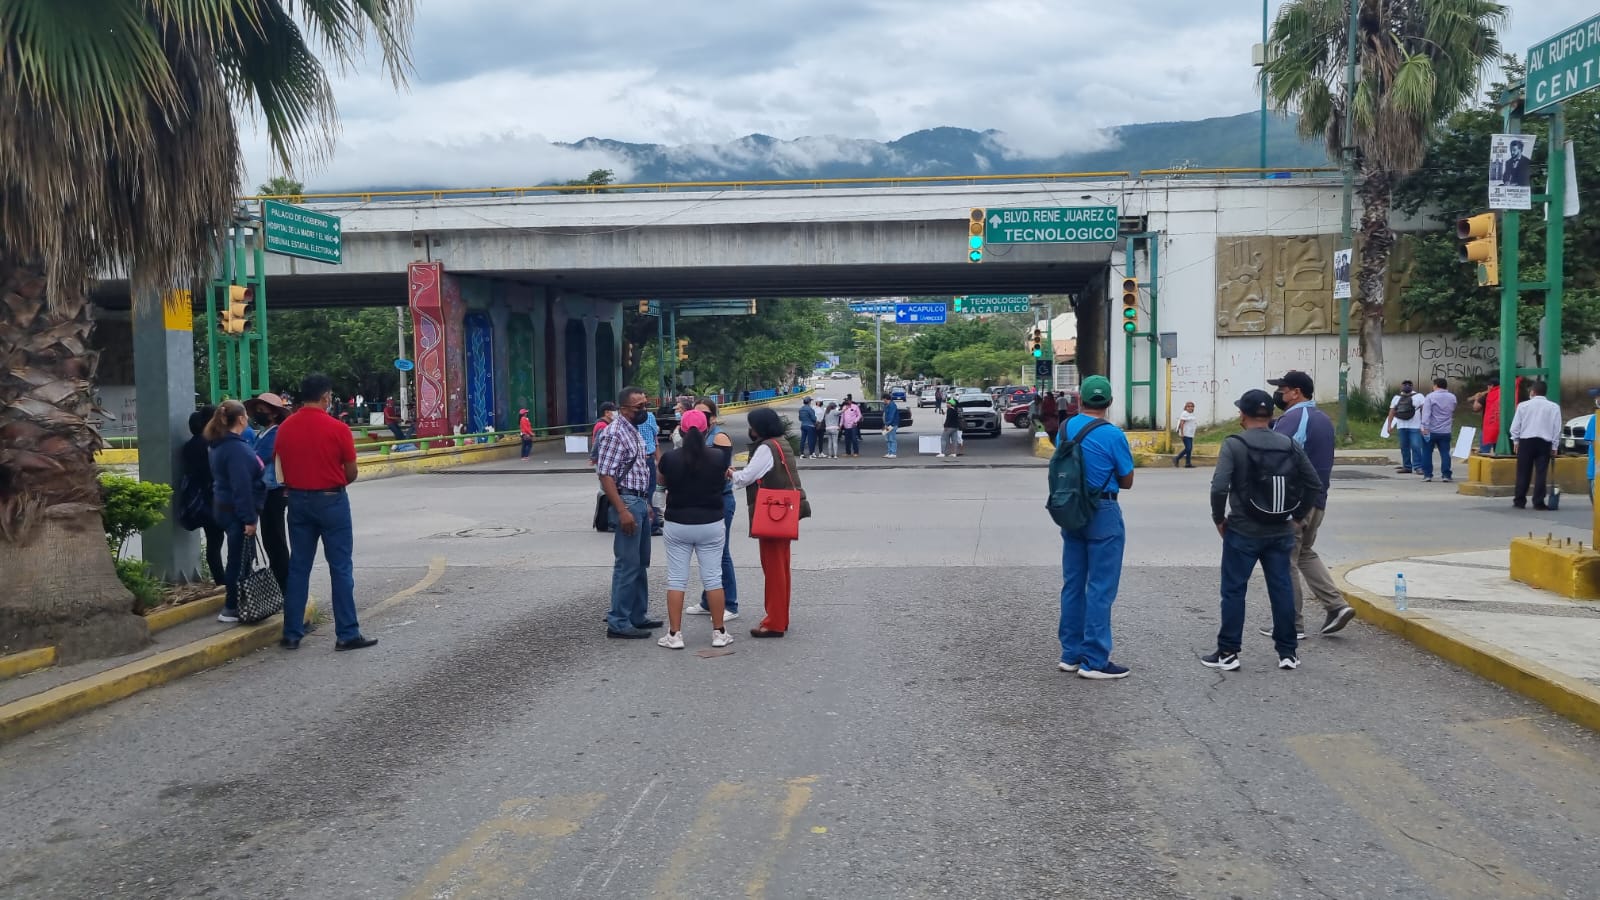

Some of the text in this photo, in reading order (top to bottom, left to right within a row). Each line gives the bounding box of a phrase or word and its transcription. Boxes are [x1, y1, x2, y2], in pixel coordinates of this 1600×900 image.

[1529, 48, 1544, 74] AV.
[1549, 28, 1585, 64] RUFFO
[271, 208, 328, 228] PALACIO DE GOBIERNO
[1003, 210, 1031, 223] BLVD.
[1033, 210, 1060, 222] RENE
[1063, 209, 1104, 222] JUAREZ
[1003, 227, 1116, 241] TECNOLOGICO
[268, 235, 291, 247] TRIBUNAL
[970, 296, 1028, 305] TECNOLOGICO
[908, 305, 945, 313] ACAPULCO
[970, 304, 1029, 313] ACAPULCO
